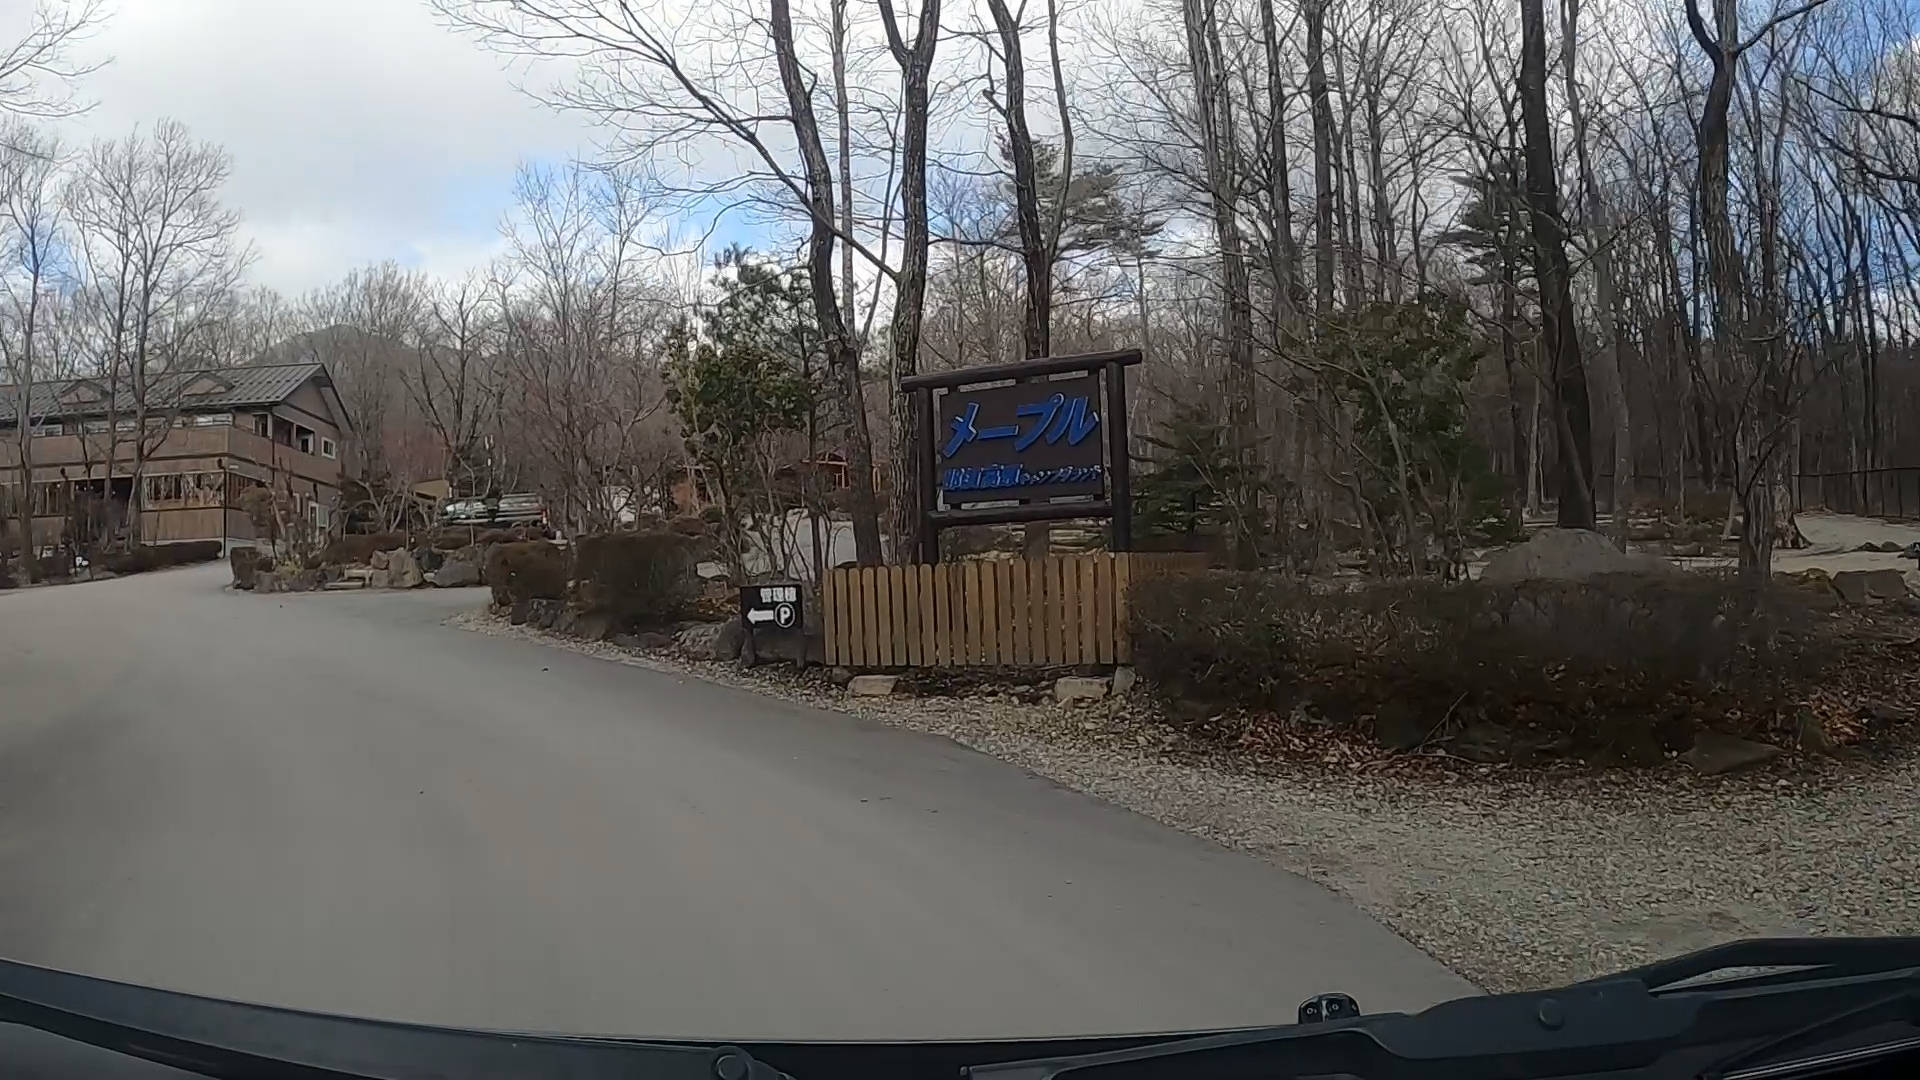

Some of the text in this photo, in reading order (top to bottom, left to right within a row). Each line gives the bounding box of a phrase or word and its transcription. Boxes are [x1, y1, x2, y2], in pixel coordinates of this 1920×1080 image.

[942, 393, 1099, 458] メープル
[780, 606, 791, 624] P
